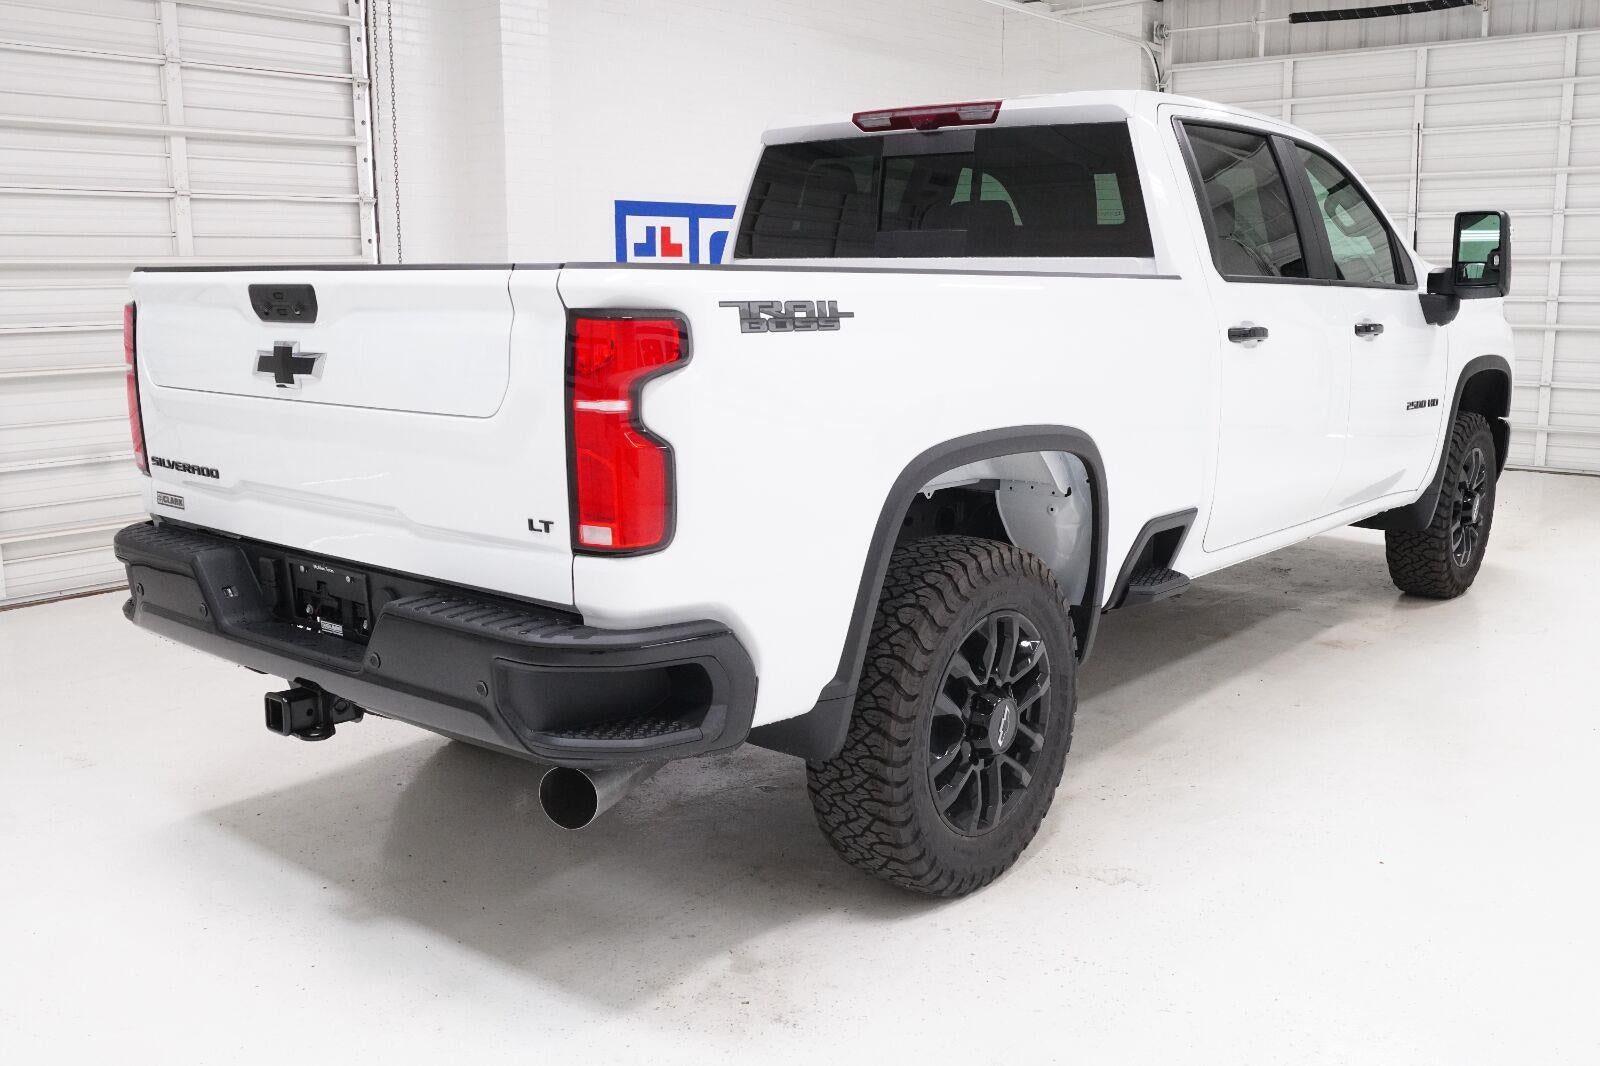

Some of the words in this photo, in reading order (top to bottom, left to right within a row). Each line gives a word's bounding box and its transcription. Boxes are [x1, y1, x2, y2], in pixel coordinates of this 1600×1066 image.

[719, 300, 854, 319] TRAIL
[740, 317, 841, 333] BOSS
[1406, 400, 1426, 410] 2500
[1427, 399, 1439, 407] HD
[151, 455, 220, 479] SILVERADO
[527, 518, 554, 533] LT
